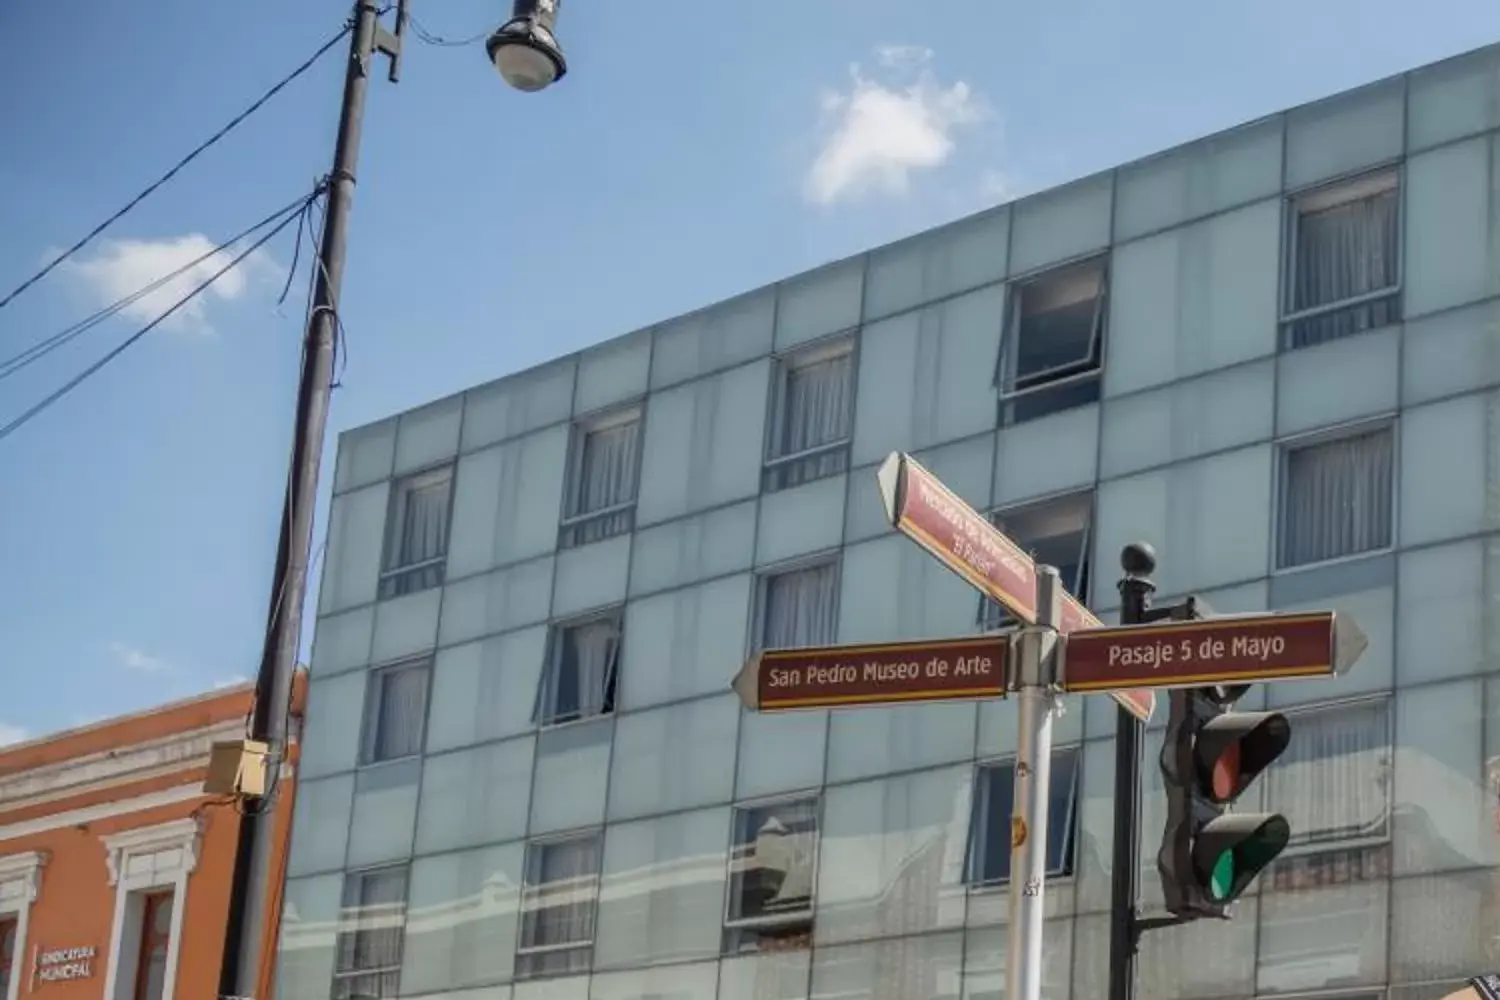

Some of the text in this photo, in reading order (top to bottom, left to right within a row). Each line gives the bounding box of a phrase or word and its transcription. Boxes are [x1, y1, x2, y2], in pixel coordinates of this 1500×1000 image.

[1109, 635, 1285, 669] Pasaje 5 de Mayo
[769, 655, 992, 687] San Pedro Museo de Arte
